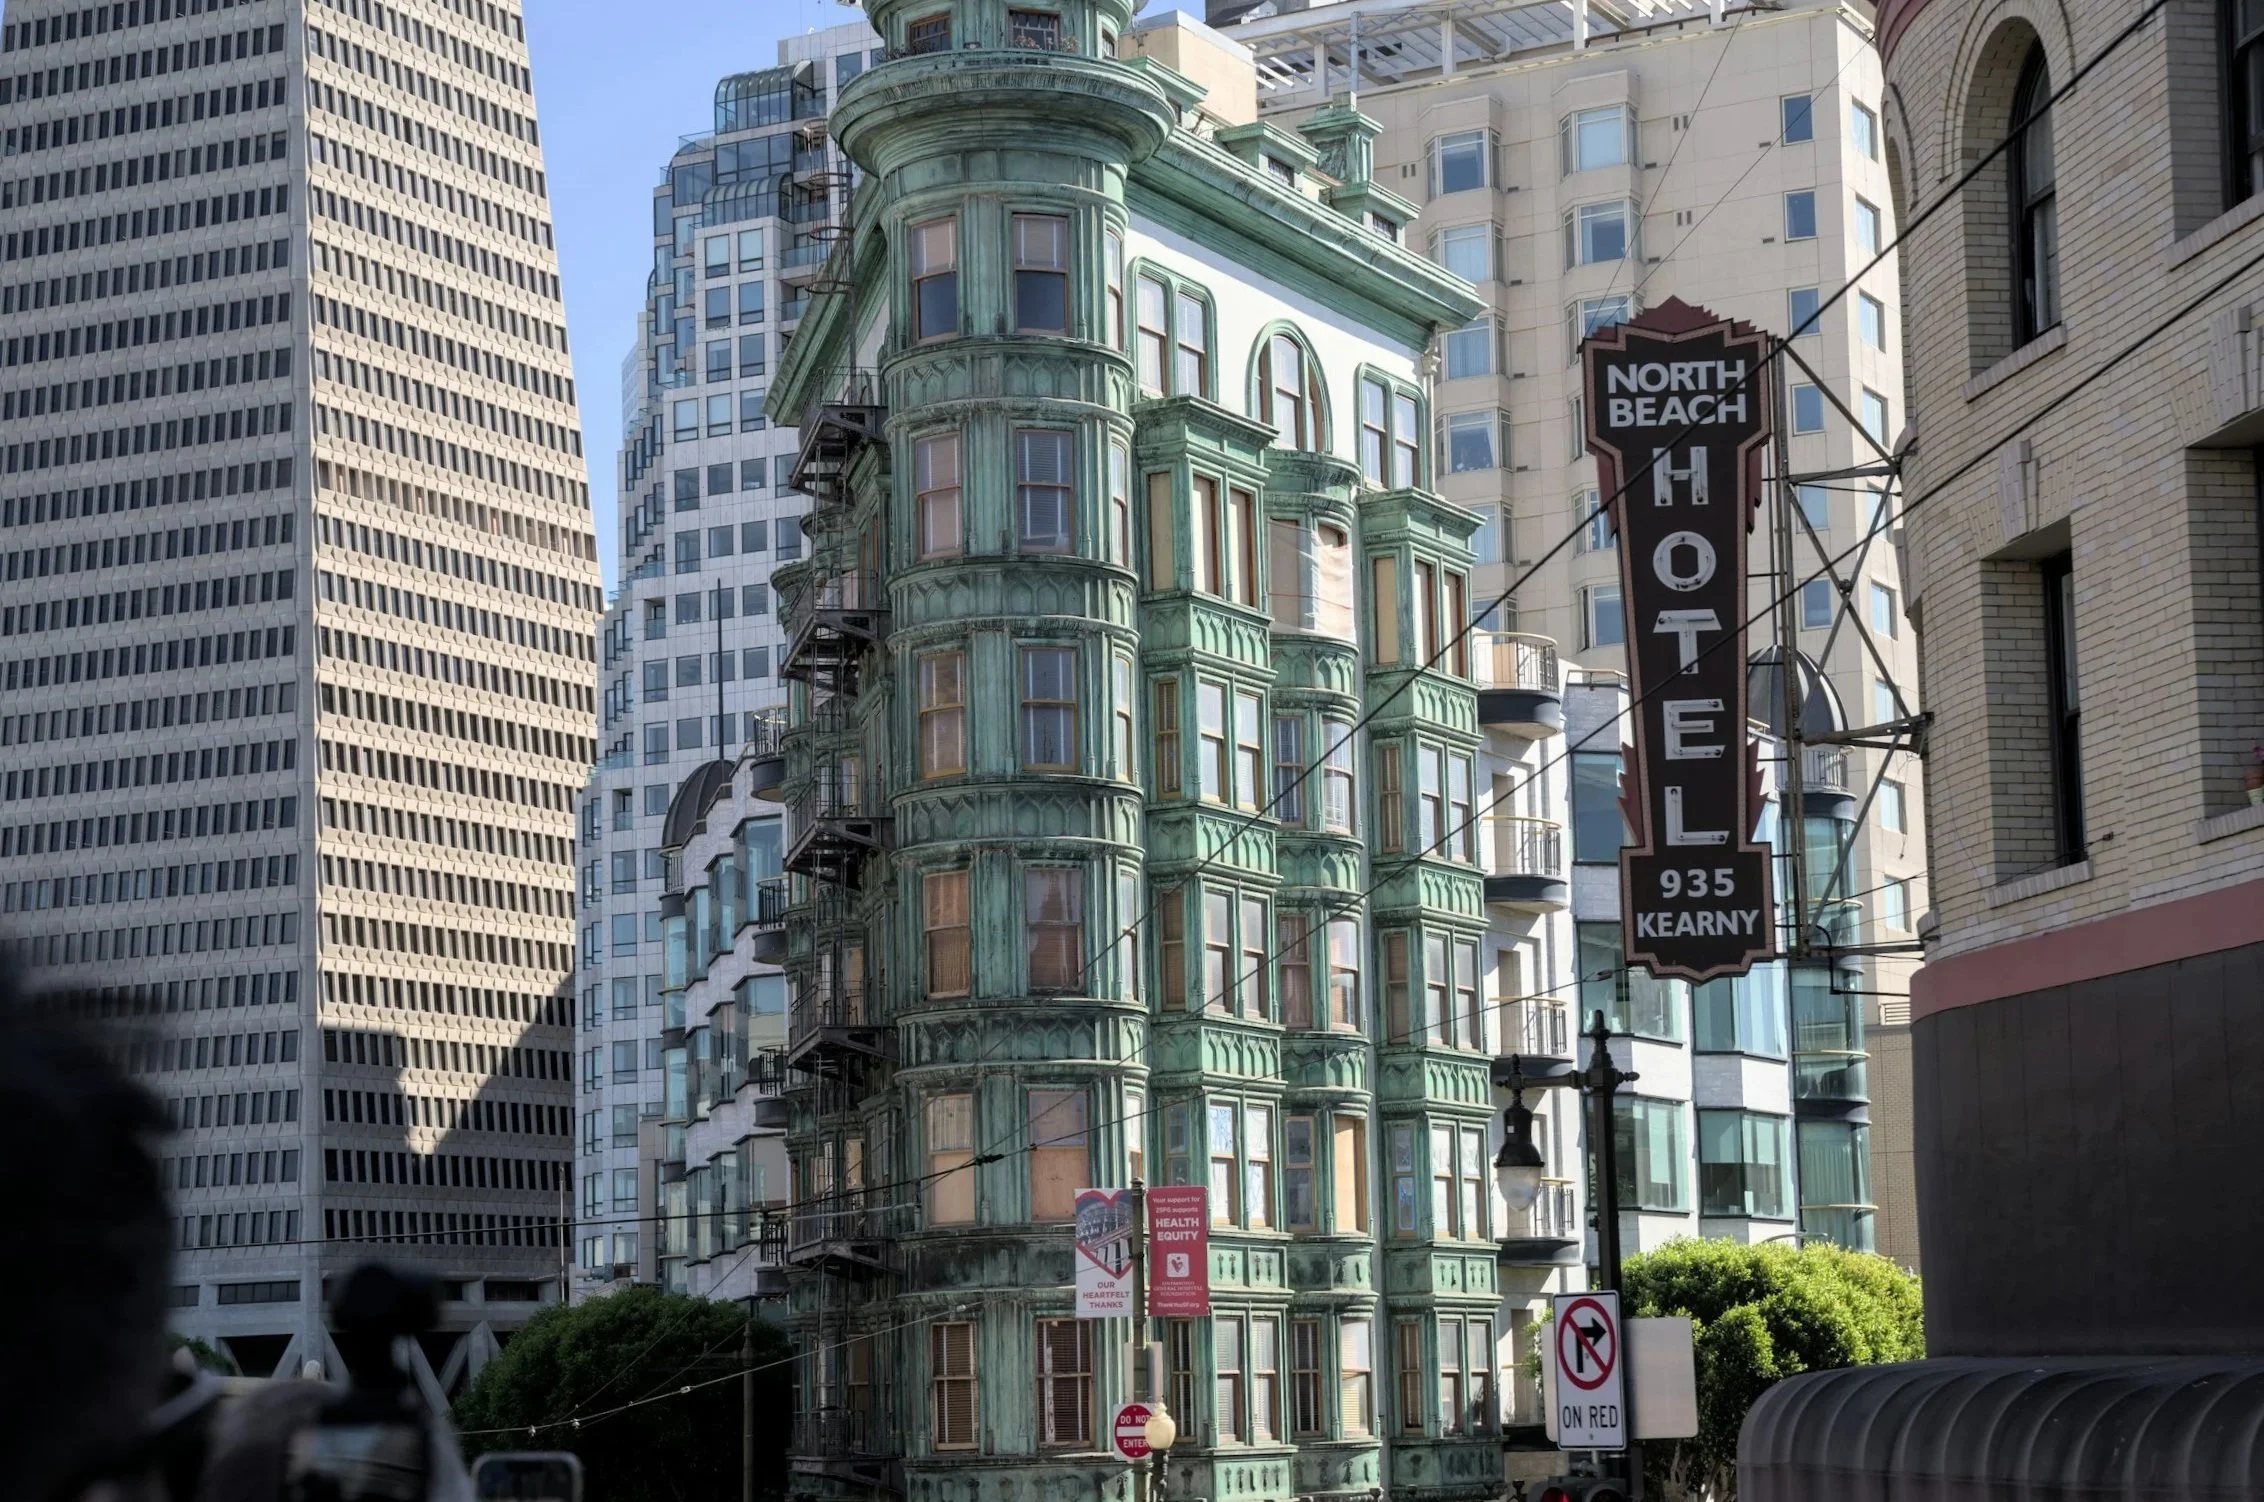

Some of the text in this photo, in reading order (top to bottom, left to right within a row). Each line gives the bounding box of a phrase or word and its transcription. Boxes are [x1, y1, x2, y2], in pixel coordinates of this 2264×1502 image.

[1607, 359, 1746, 394] NORTH
[1609, 393, 1747, 428] BEACH
[1652, 445, 1731, 847] HOTEL
[1659, 867, 1736, 899] 935
[1636, 909, 1760, 938] KEARNY
[1155, 1217, 1200, 1228] HEALTH
[1157, 1230, 1199, 1241] EQUITY
[1097, 1281, 1116, 1289] OUR
[1082, 1291, 1130, 1299] HEARTFELT
[1089, 1301, 1124, 1309] THANKS
[1120, 1415, 1131, 1425] DO
[1562, 1405, 1618, 1429] ON RED
[1123, 1438, 1149, 1449] ENTER
